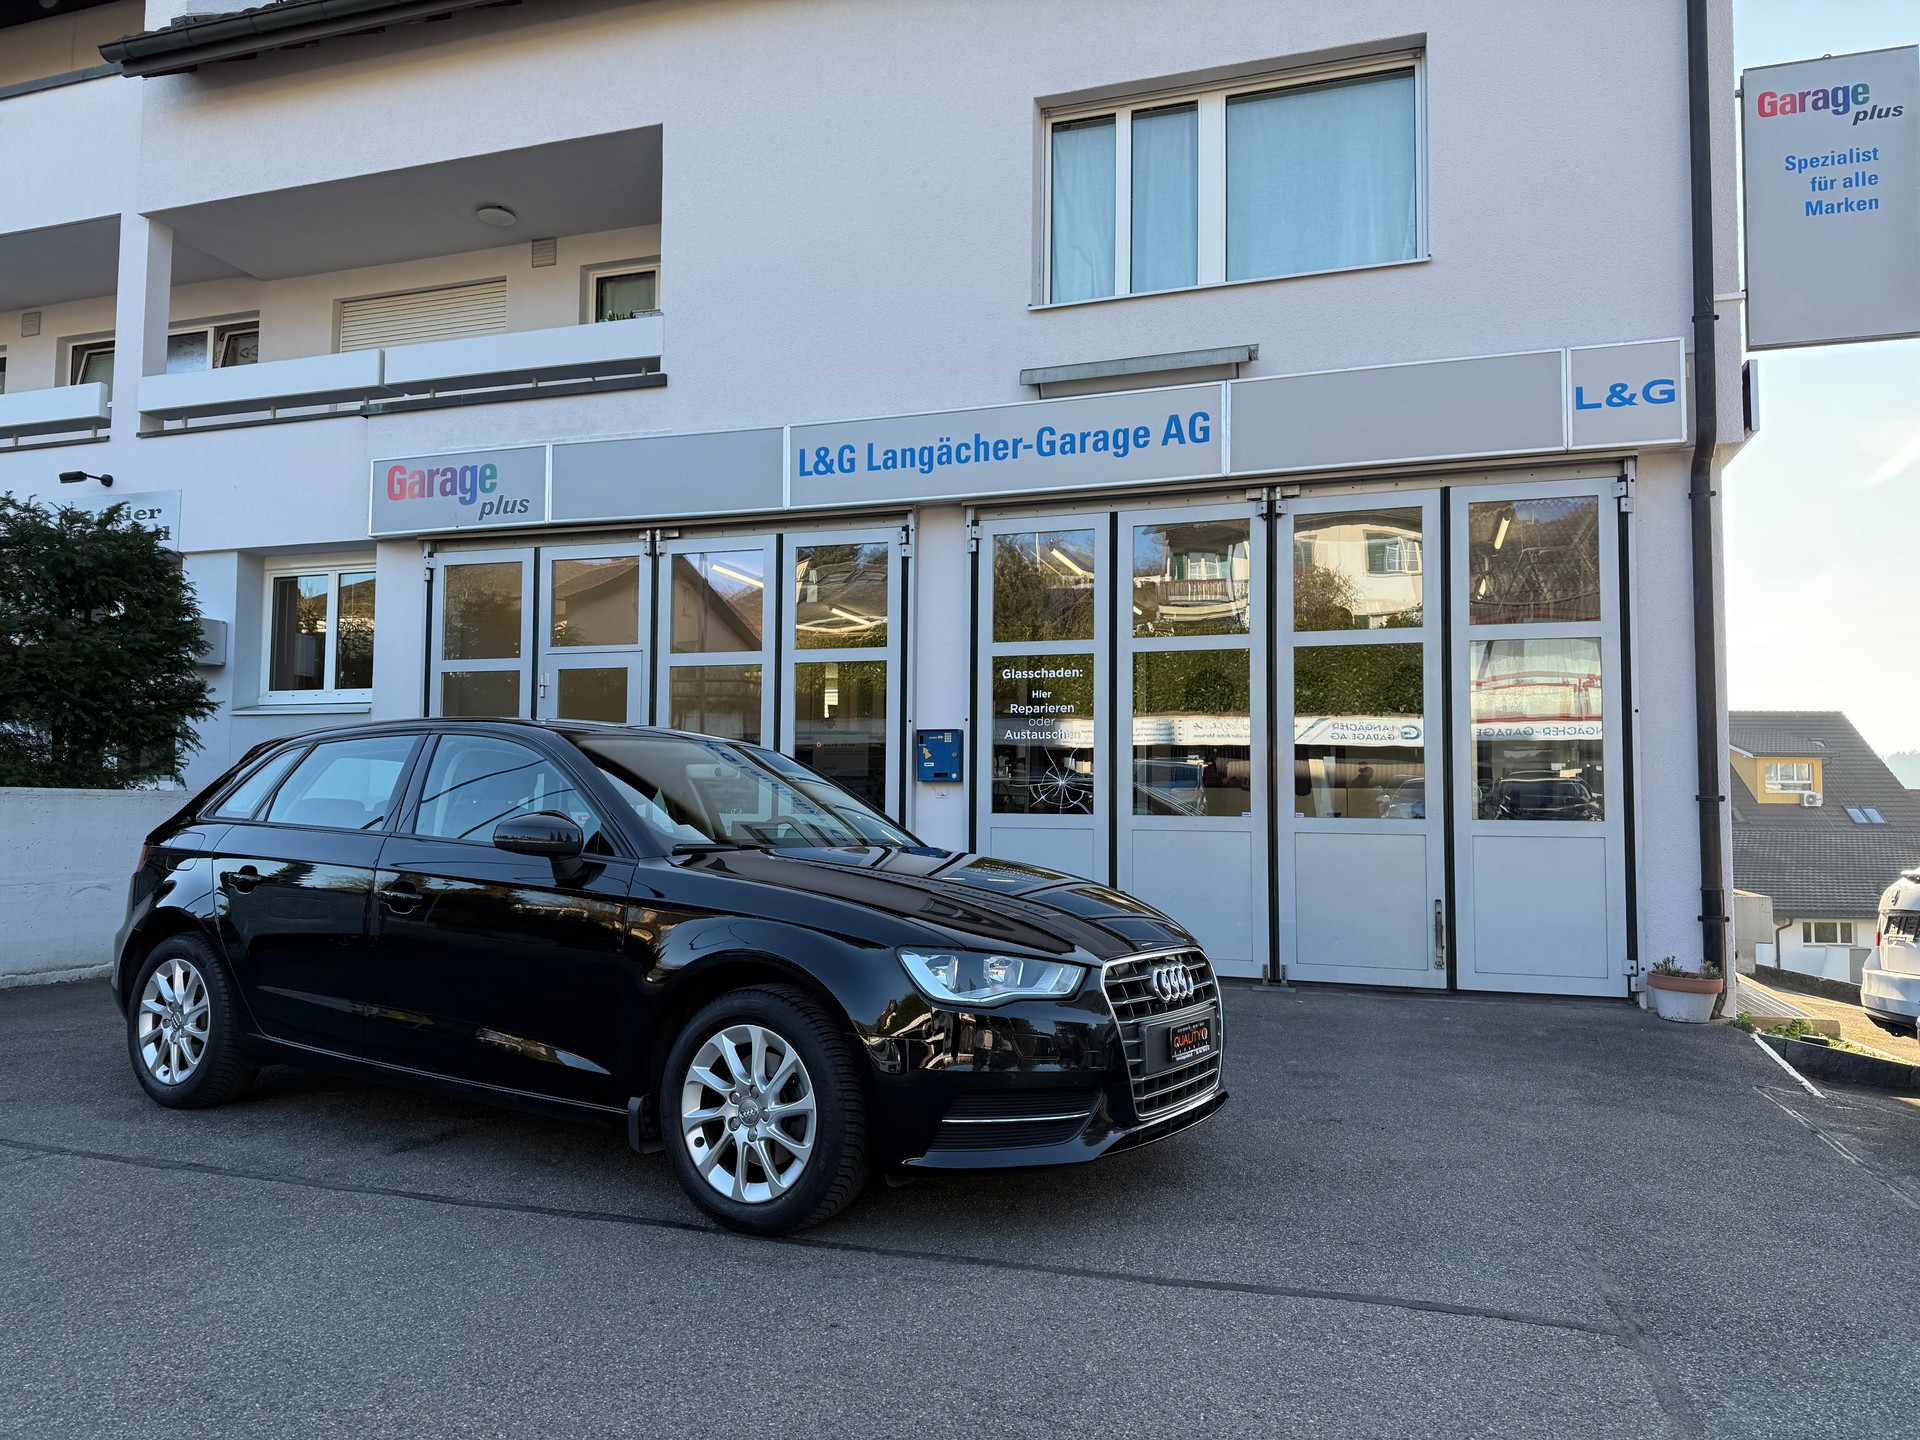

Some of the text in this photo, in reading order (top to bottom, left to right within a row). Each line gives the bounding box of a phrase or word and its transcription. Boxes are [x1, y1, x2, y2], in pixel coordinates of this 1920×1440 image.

[1757, 83, 1870, 118] Garage
[1852, 104, 1904, 125] plus
[1784, 147, 1879, 173] Spezialist
[1810, 171, 1879, 192] für alle
[1804, 197, 1879, 216] Marken
[1575, 378, 1676, 410] L&G
[799, 411, 1211, 477] L&G Langächer-Garage AG
[387, 463, 498, 506] Garage
[478, 494, 530, 521] plus
[1002, 668, 1083, 680] Glasschaden:
[1031, 690, 1052, 699] Hier
[1010, 703, 1075, 715] Reparieren
[1028, 717, 1056, 727] oder
[1004, 729, 1081, 740] Austauschen
